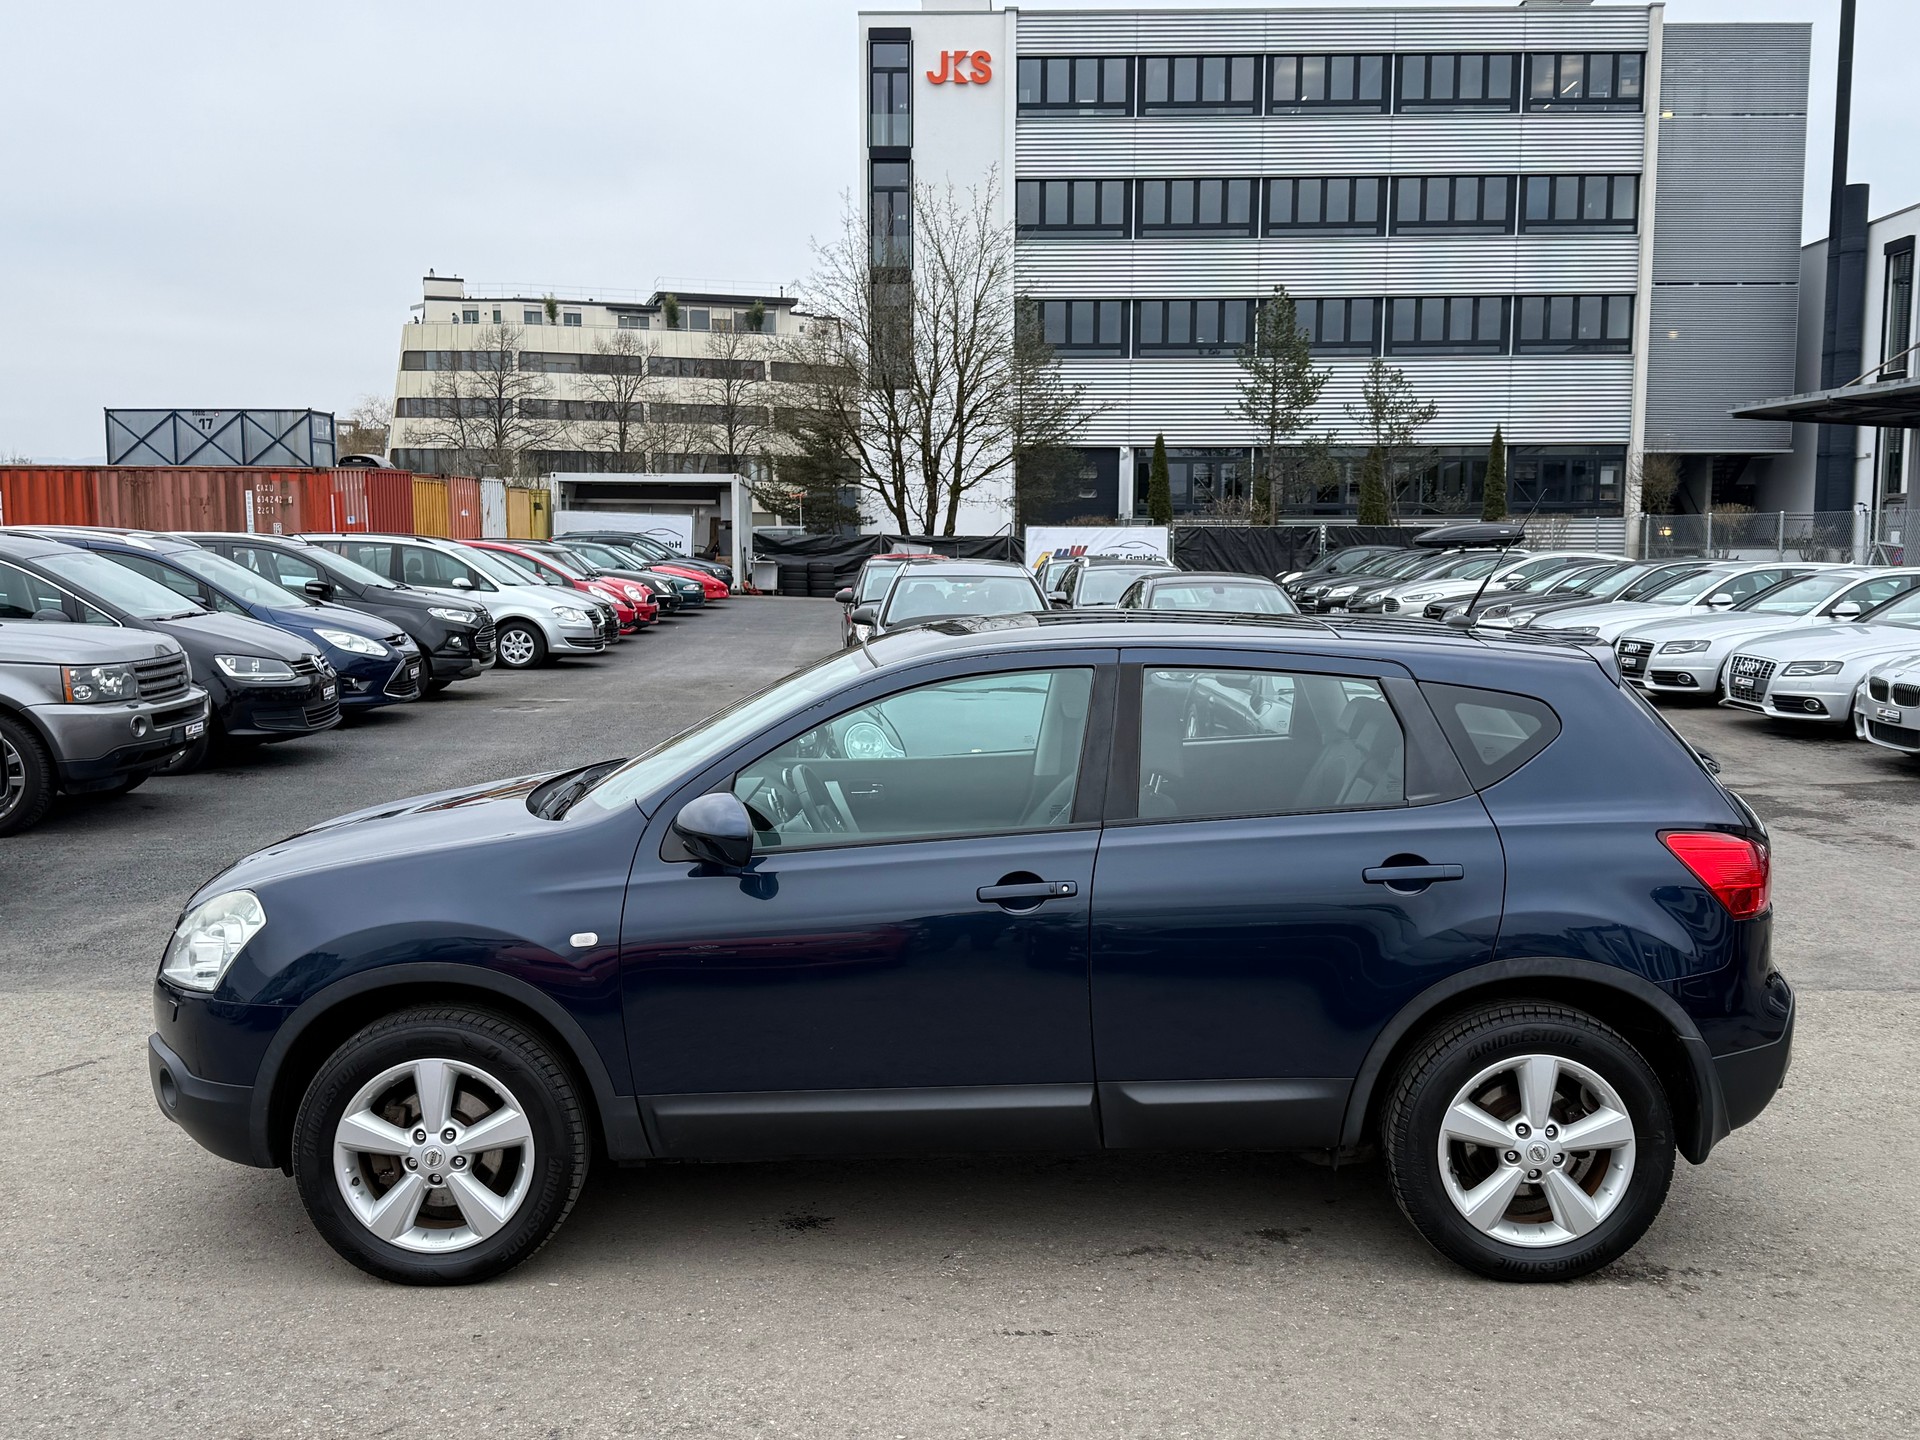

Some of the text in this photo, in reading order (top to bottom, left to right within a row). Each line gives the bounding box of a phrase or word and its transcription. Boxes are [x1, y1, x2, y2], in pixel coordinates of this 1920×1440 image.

[926, 50, 992, 84] JKS
[198, 418, 213, 429] 17
[1466, 1028, 1584, 1060] BRIDGESTONE
[502, 1157, 563, 1262] BRIDGESTONE
